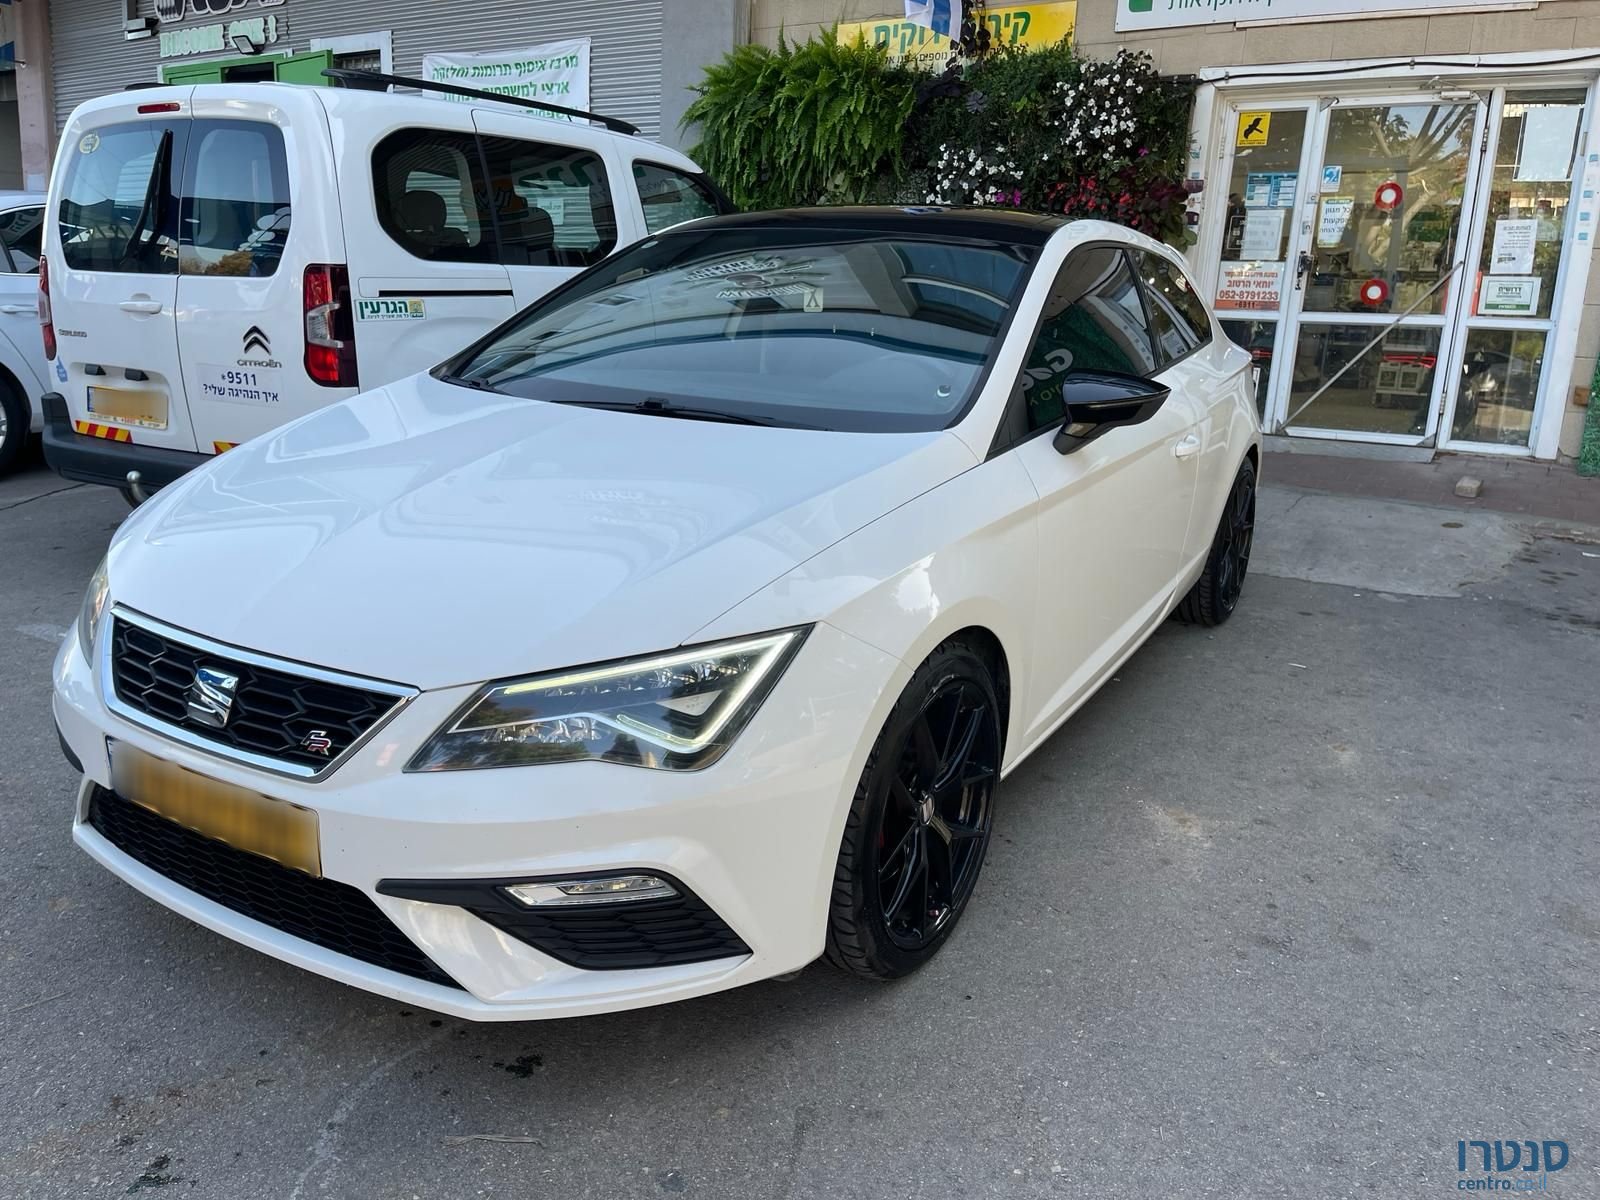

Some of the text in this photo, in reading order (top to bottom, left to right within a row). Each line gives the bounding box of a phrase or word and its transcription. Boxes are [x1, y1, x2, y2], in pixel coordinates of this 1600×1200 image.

[432, 54, 578, 82] מרכז איסוף תרומות וחלוקה
[542, 81, 570, 95] ארצי
[1227, 280, 1251, 288] הרטוב
[1219, 290, 1279, 300] 052-8791233
[359, 300, 408, 319] הגרעין
[203, 383, 279, 403] איך הנהיגה שלי?
